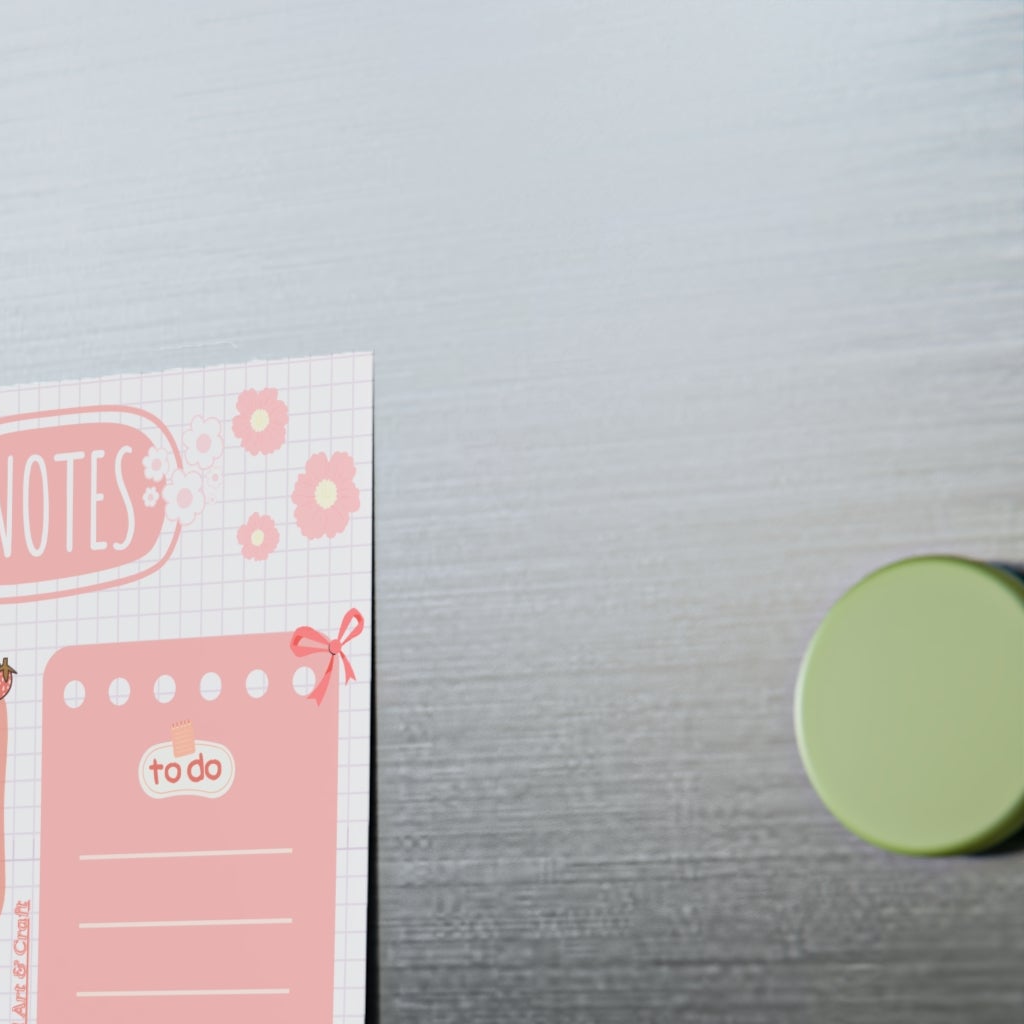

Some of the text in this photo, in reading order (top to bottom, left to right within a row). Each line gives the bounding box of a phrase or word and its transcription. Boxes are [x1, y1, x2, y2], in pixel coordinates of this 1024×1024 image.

[148, 752, 222, 785] to do
[14, 900, 31, 957] Craft
[13, 959, 27, 980] &
[12, 983, 27, 1019] Art
